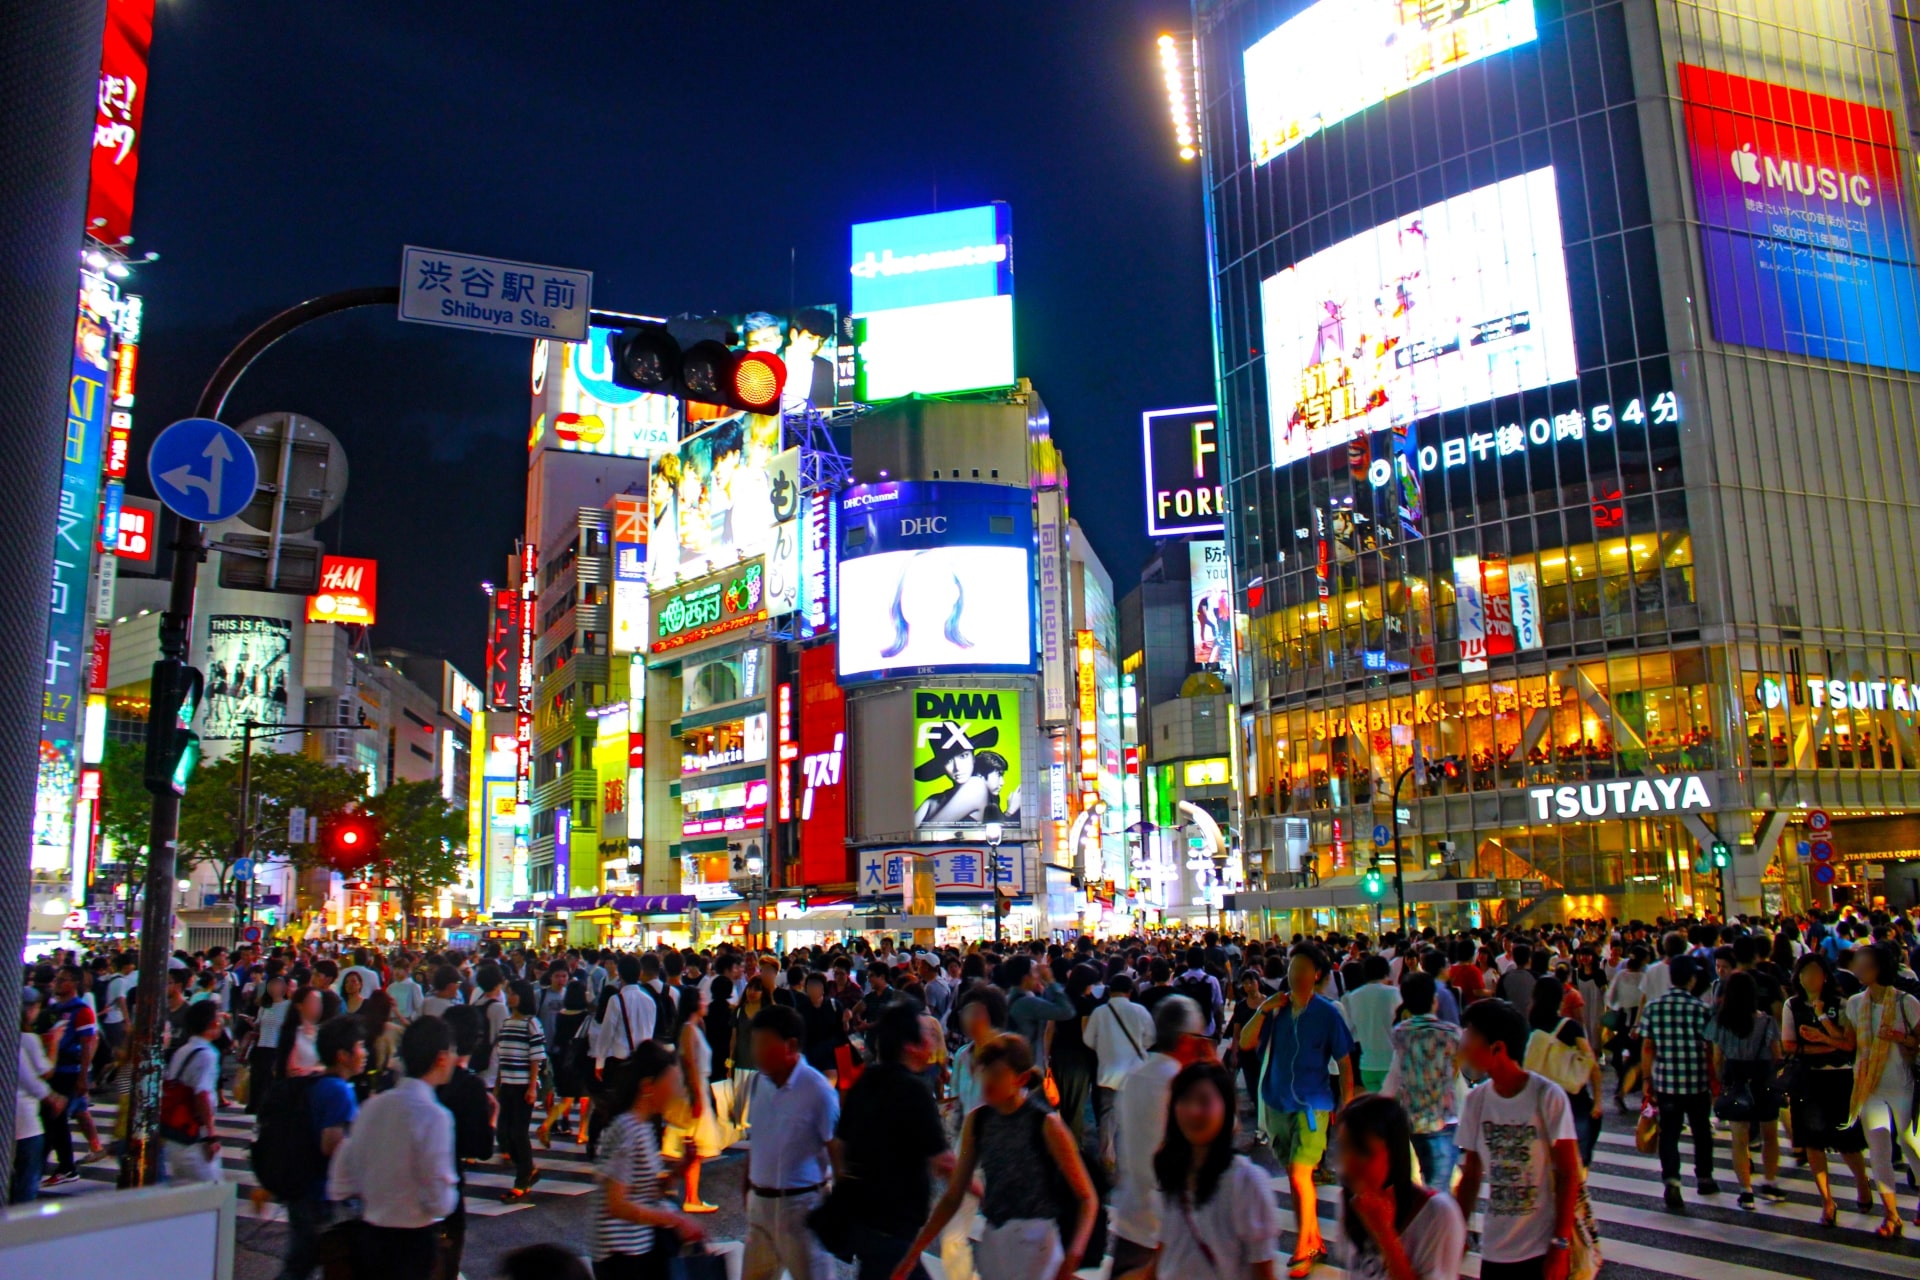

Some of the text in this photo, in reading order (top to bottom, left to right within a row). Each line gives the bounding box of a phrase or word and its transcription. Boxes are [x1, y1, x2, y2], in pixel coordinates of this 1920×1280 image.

[1764, 155, 1871, 207] MUSIC
[418, 259, 576, 310] 渋谷駅前
[441, 299, 556, 330] Shibuya Sta.
[634, 429, 669, 442] VISA
[1191, 421, 1216, 479] F
[843, 490, 899, 509] DHC Channel
[901, 516, 948, 536] DHC
[1205, 546, 1226, 562] 防
[322, 564, 364, 592] H&M
[1041, 517, 1058, 662] Taisei neon
[211, 620, 236, 630] THIS
[240, 620, 251, 631] IS
[685, 593, 721, 628] 西村
[917, 666, 935, 674] DHC
[916, 692, 1003, 720] DMM
[1313, 684, 1563, 741] STARBUCKS COFFEE
[917, 721, 974, 750] FX
[1530, 775, 1711, 820] TSUTAYA
[865, 854, 1014, 886] 大盛書店
